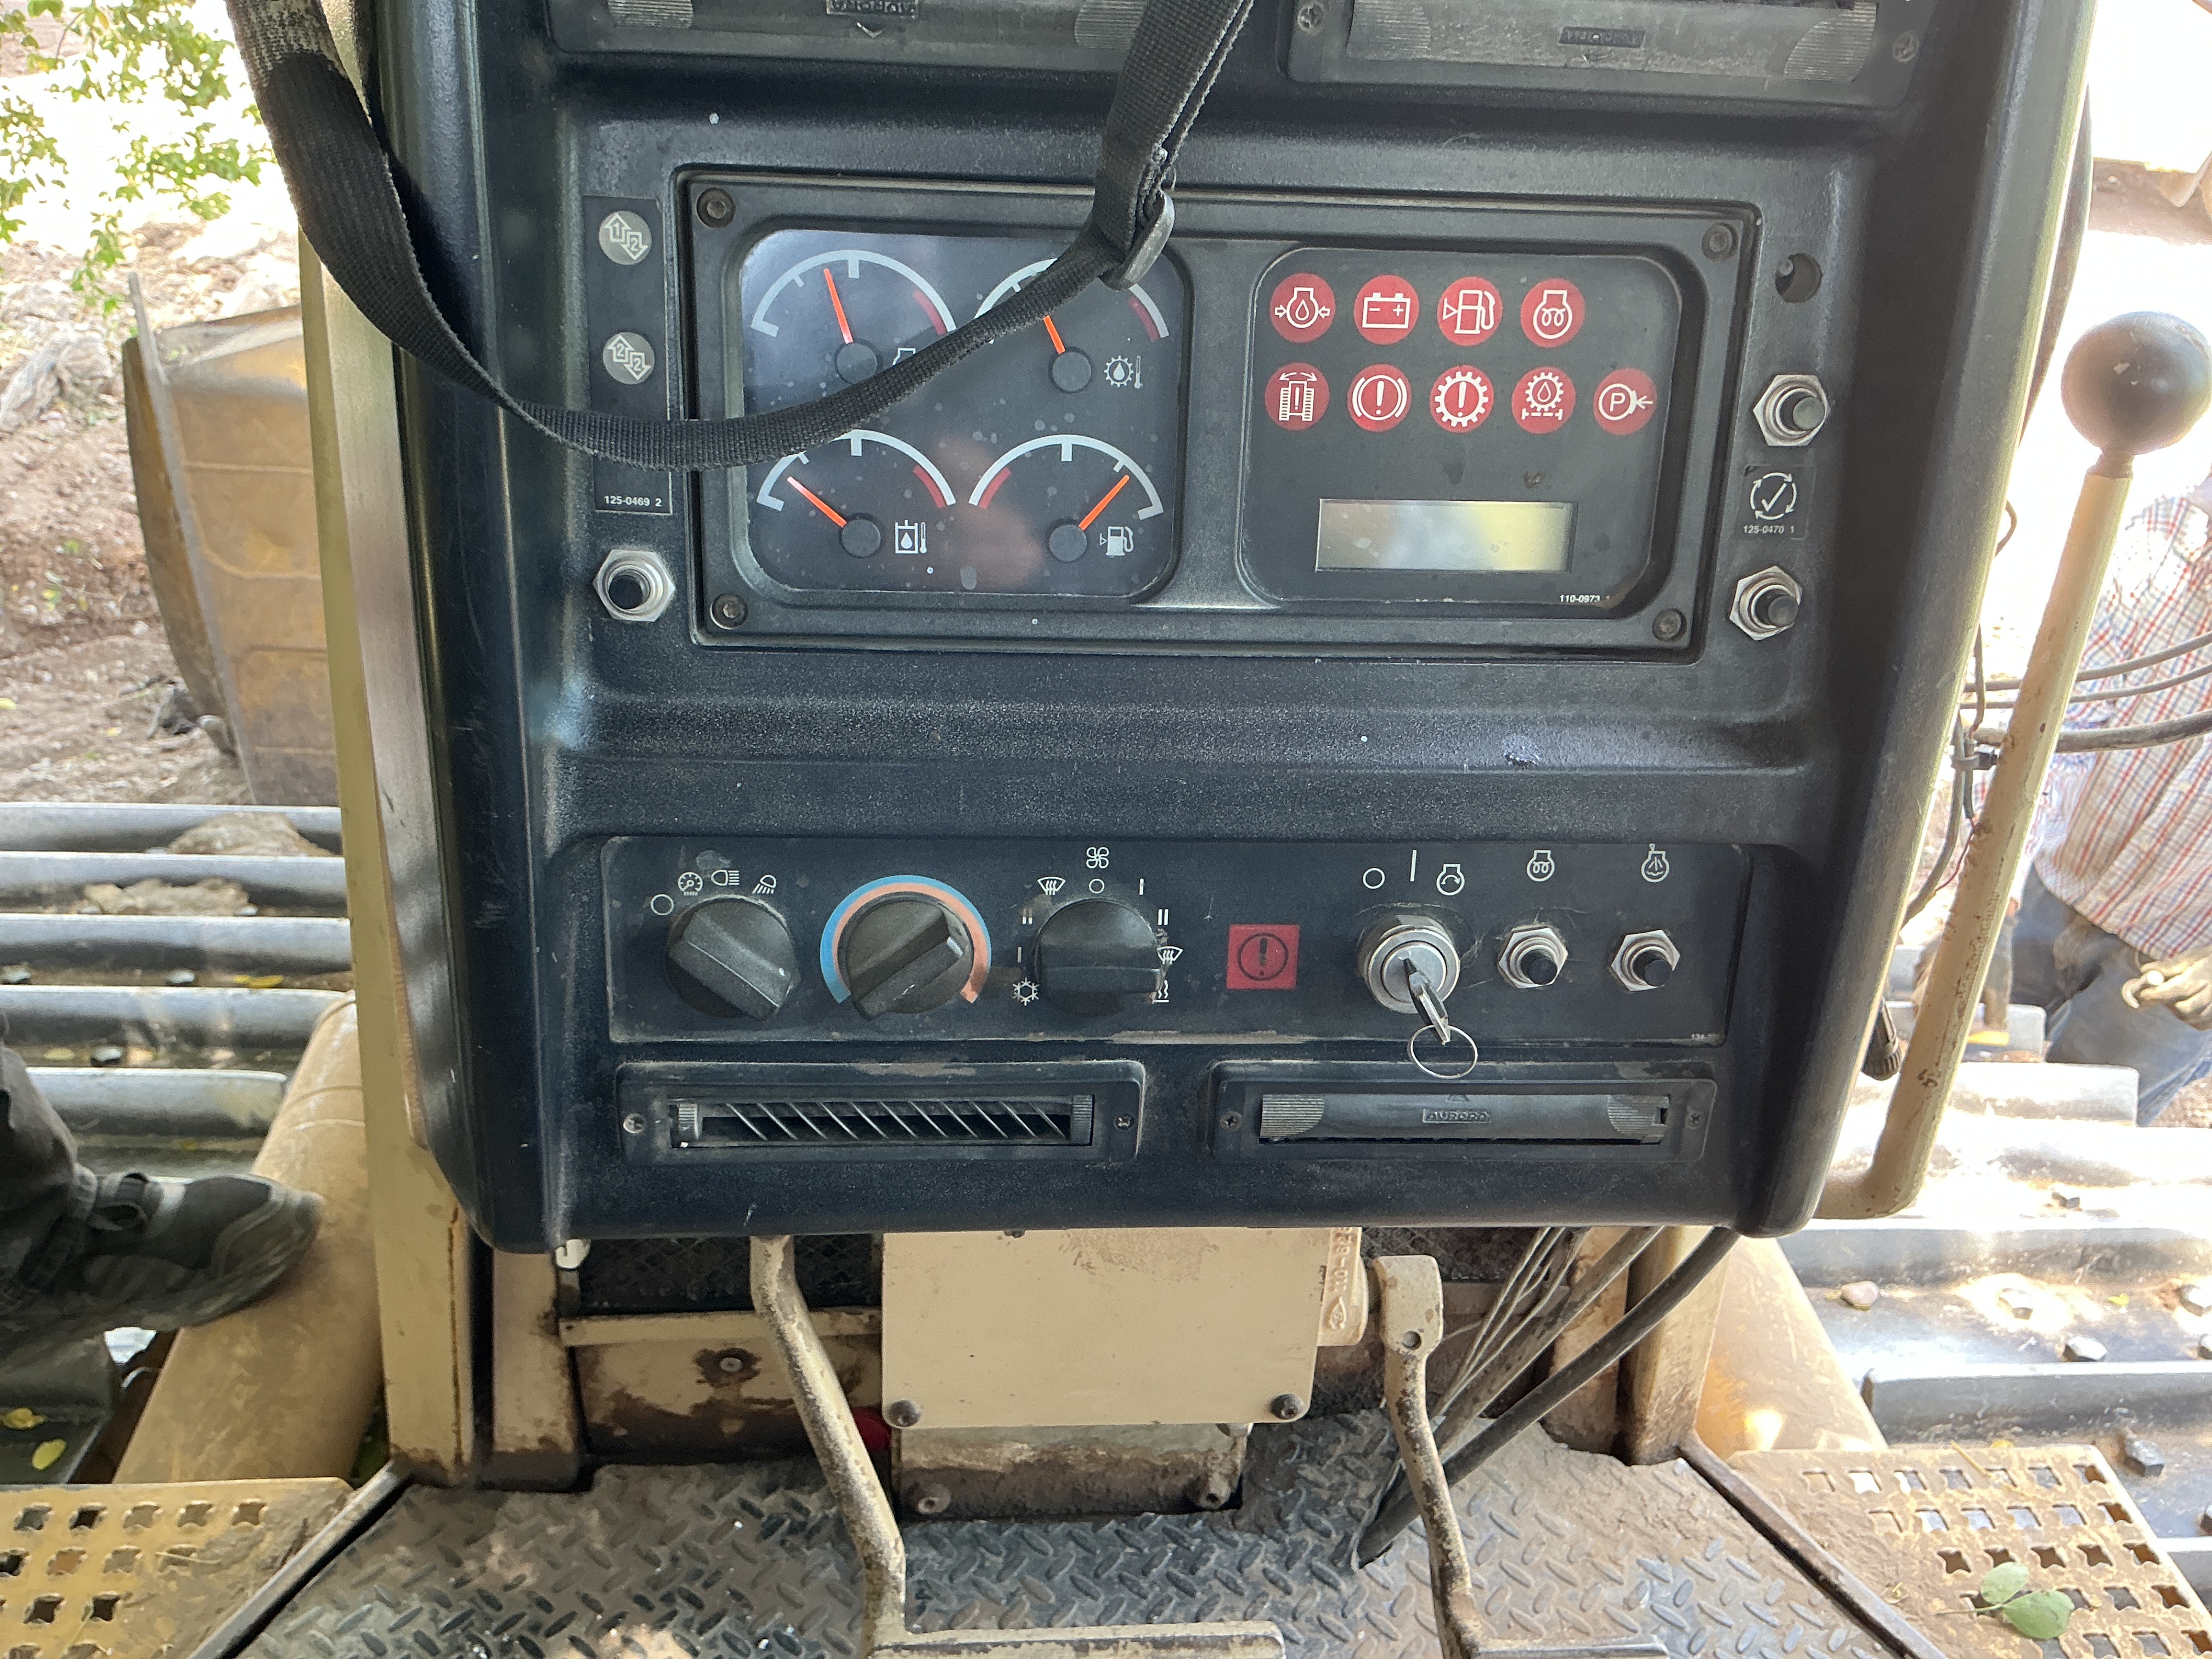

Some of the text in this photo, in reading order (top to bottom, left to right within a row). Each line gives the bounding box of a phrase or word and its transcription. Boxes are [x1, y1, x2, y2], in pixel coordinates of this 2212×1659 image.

[604, 495, 662, 507] 125-0469 2
[1743, 524, 1795, 534] 125-0470 1
[1560, 594, 1601, 603] 110-0973
